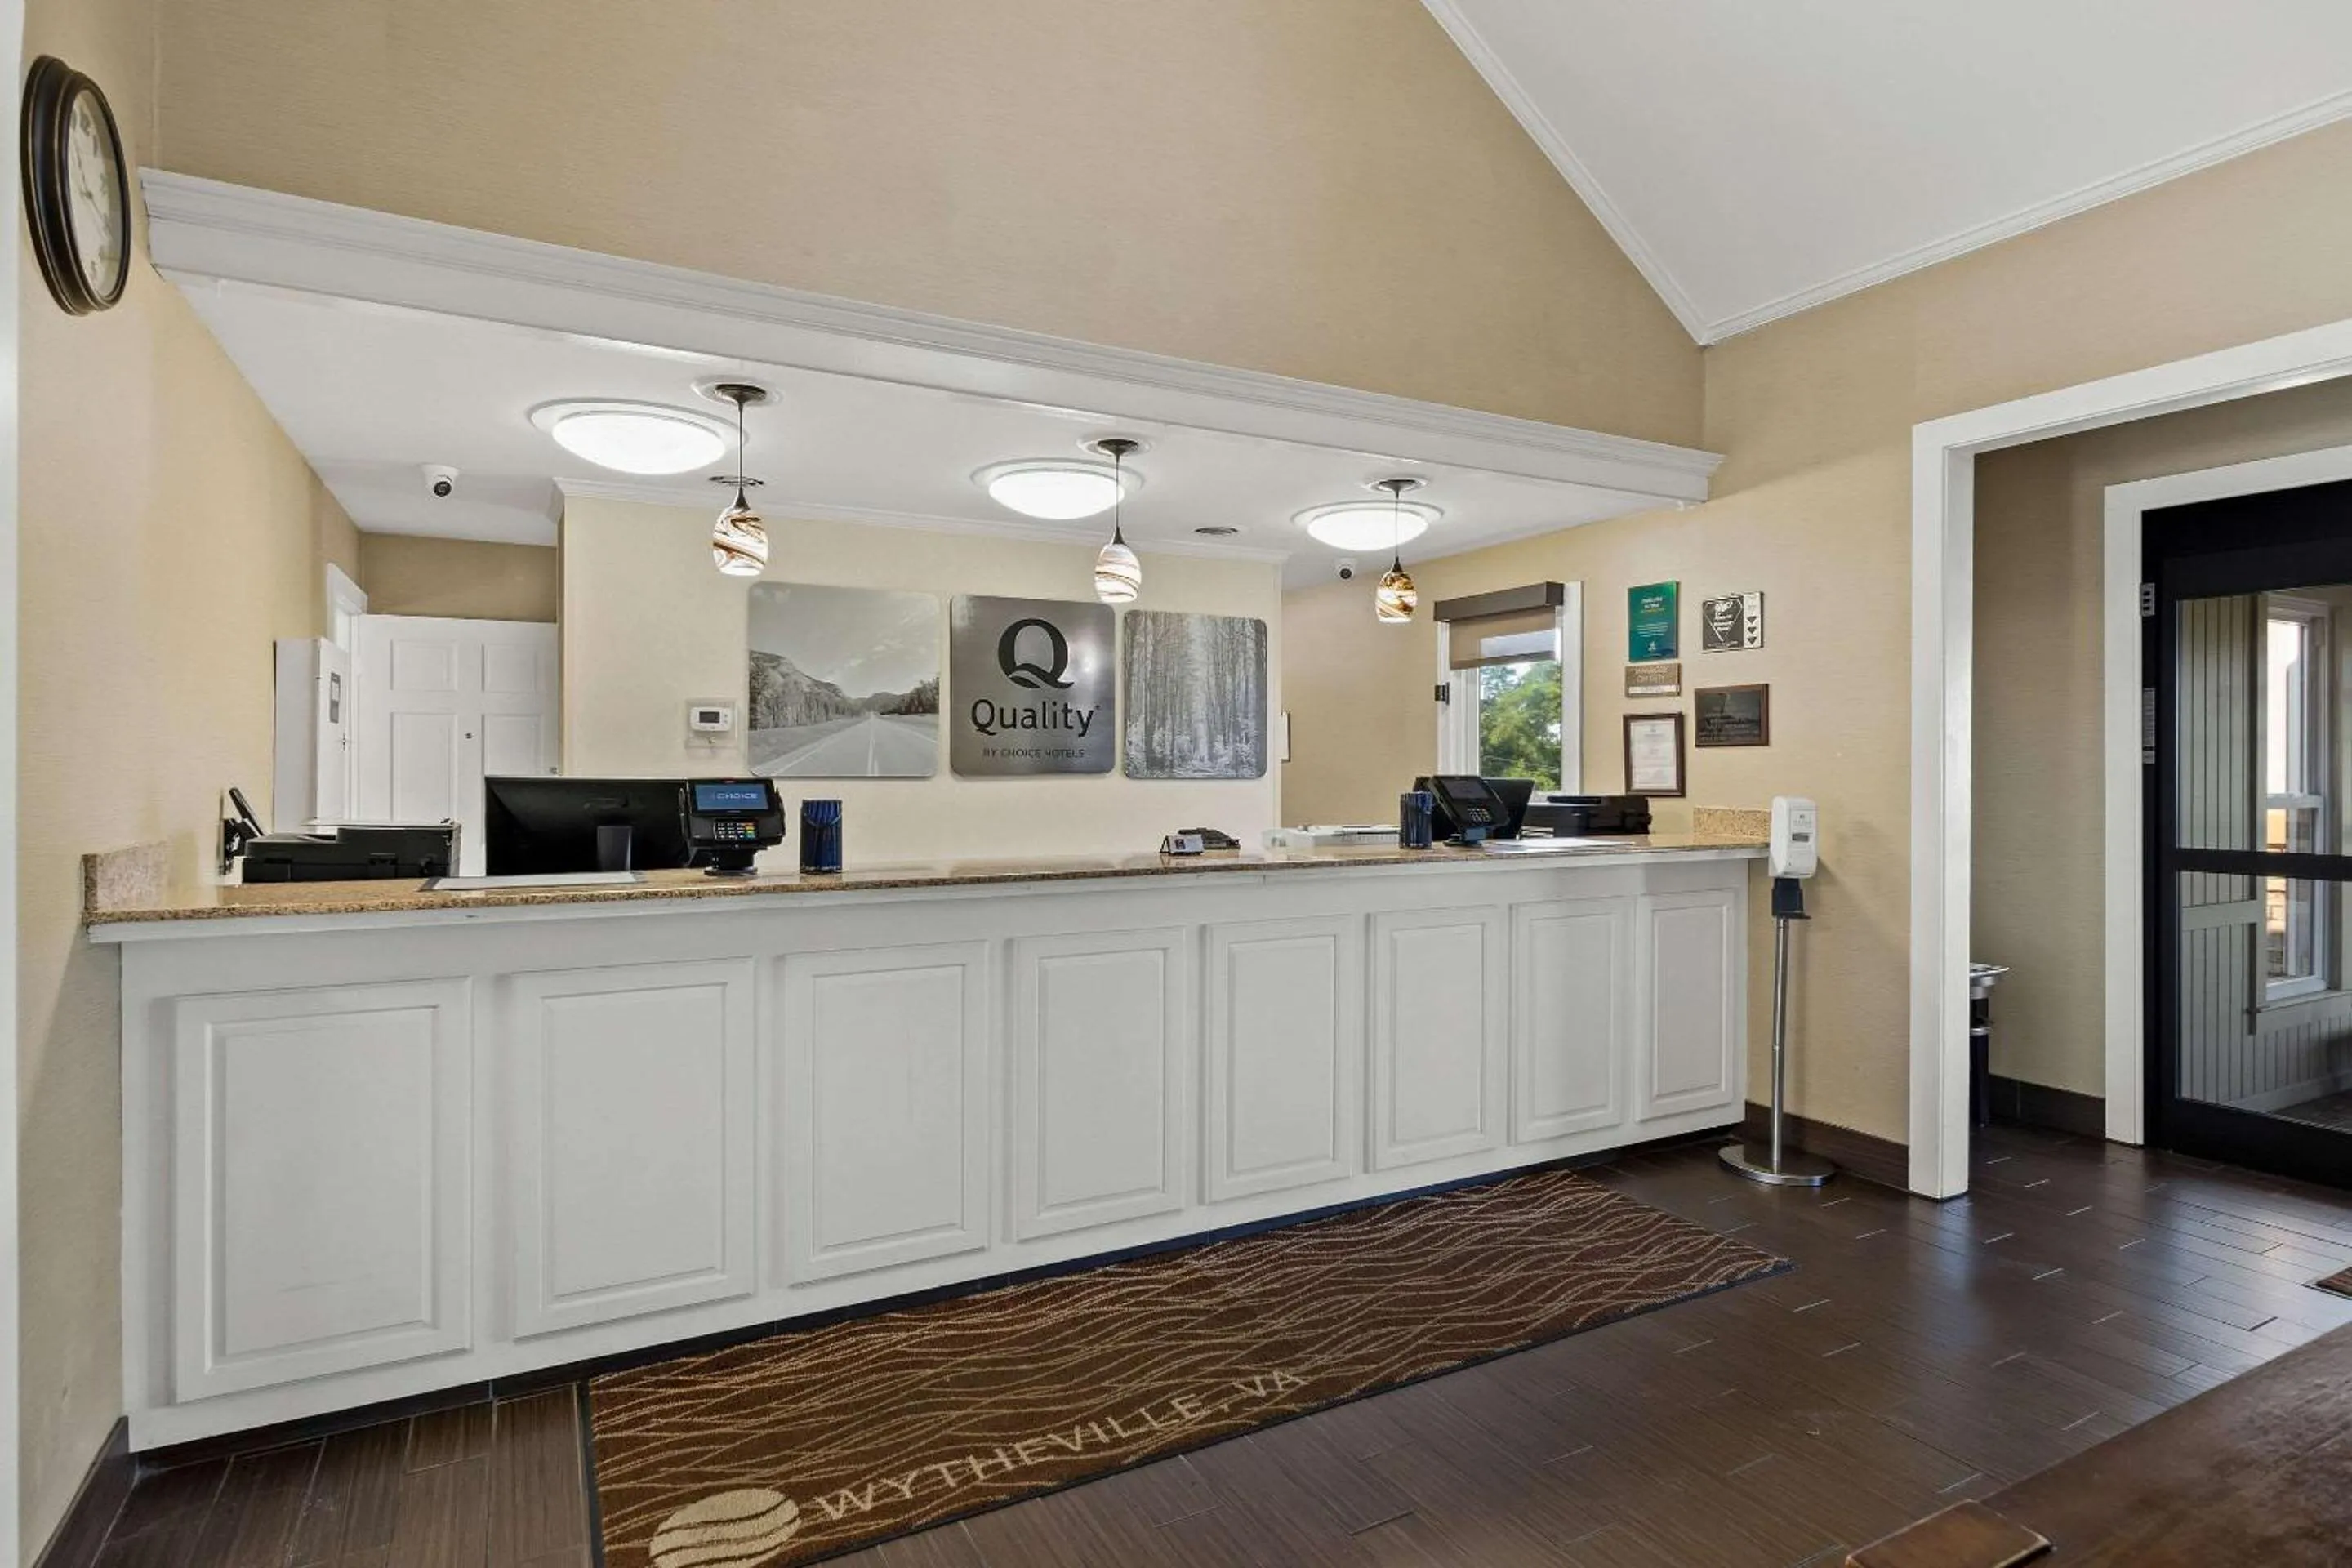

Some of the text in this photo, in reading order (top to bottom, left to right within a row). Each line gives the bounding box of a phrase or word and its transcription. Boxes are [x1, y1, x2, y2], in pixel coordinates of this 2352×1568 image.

[998, 618, 1075, 689] Q
[971, 698, 1095, 737] Quality
[983, 749, 1085, 759] BY CHOICE HOTELS
[1231, 1370, 1309, 1398] VA
